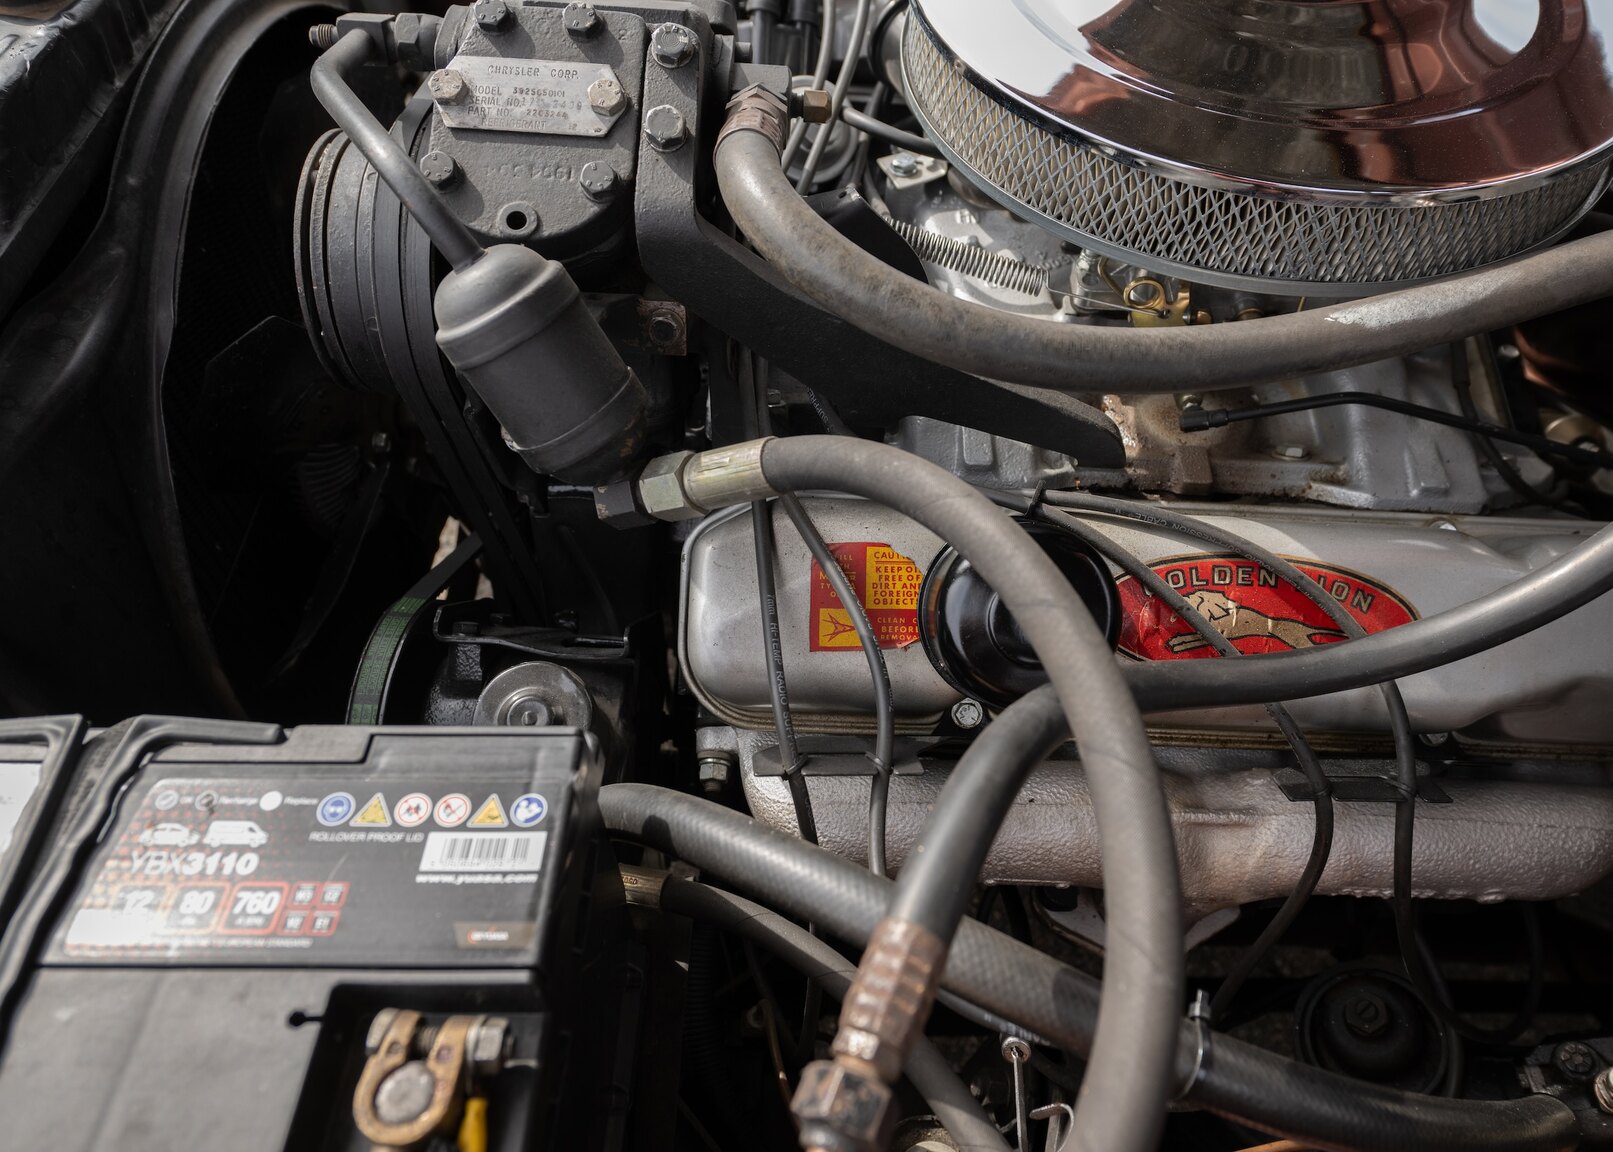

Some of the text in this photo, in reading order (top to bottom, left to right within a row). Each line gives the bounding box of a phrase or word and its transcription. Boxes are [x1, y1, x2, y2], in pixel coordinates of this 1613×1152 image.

[488, 65, 580, 80] CHRYSLER CORP.
[470, 85, 503, 96] MODEL
[469, 95, 501, 106] SERIAL
[467, 106, 492, 117] PART
[496, 107, 512, 117] NO.
[1165, 564, 1374, 615] OLDEN ION
[770, 622, 784, 666] HI-TEMP
[776, 670, 788, 705] RADIO
[309, 832, 424, 842] ROLLOVER PROOF LID
[130, 851, 260, 875] YBX3110
[415, 873, 539, 885] www.yuasa.com
[180, 890, 214, 914] 80
[232, 890, 281, 914] 760
